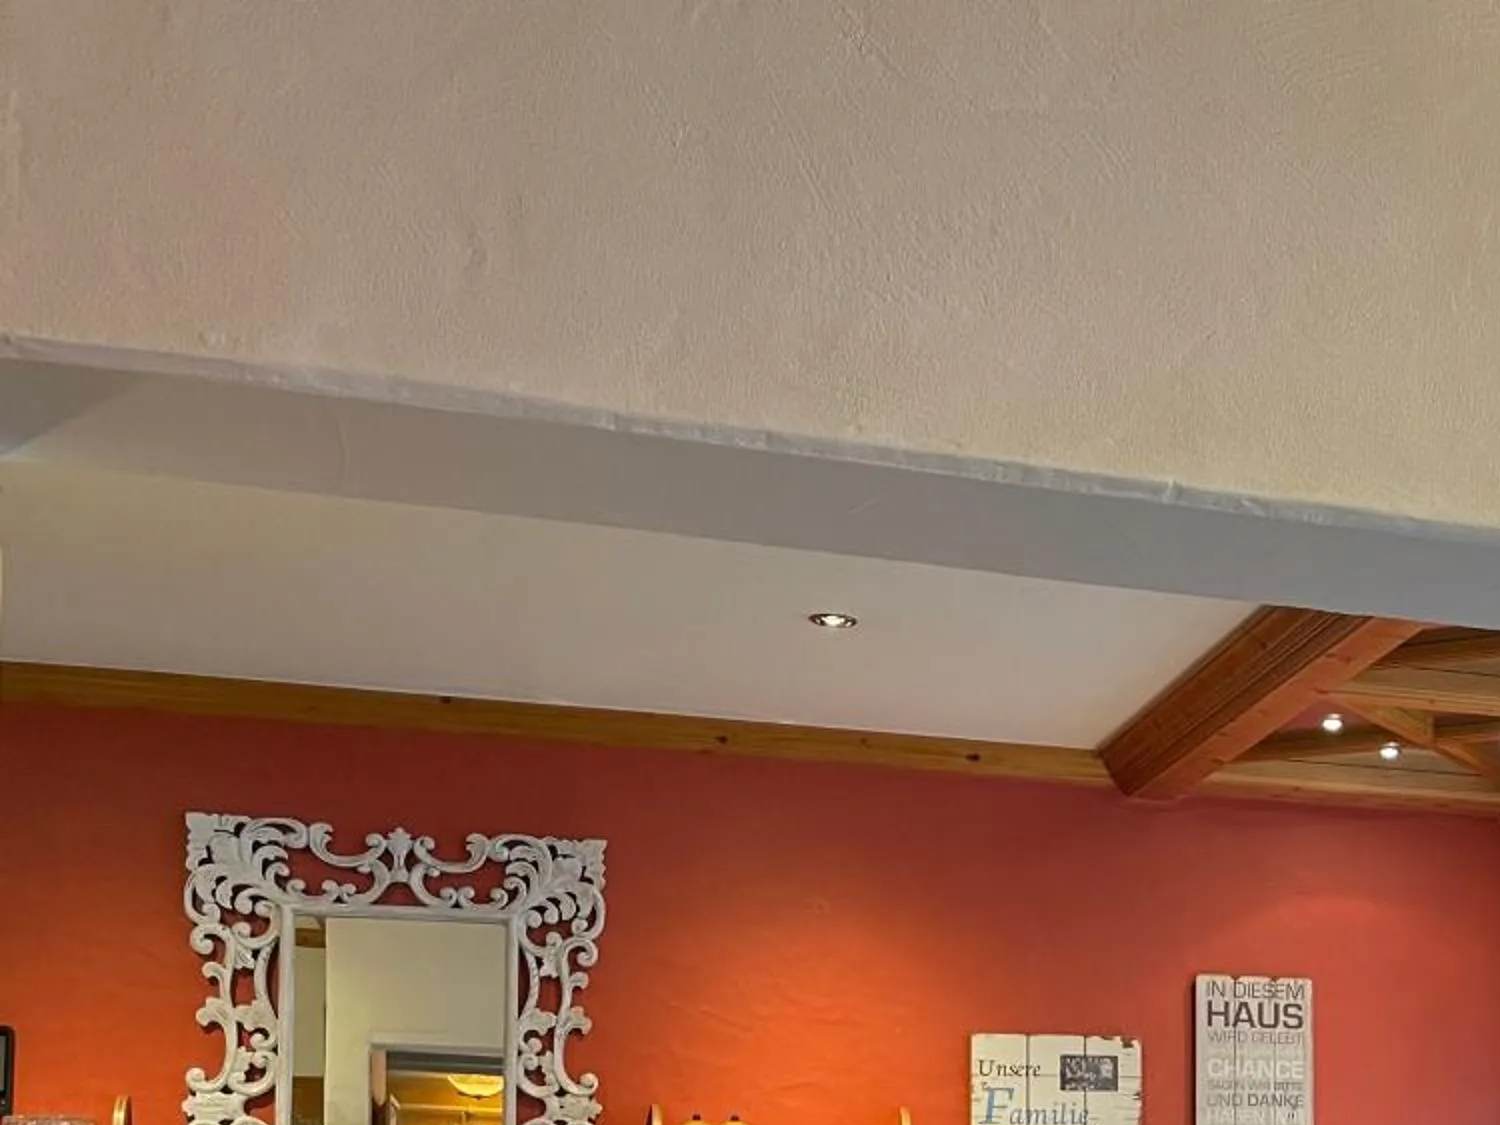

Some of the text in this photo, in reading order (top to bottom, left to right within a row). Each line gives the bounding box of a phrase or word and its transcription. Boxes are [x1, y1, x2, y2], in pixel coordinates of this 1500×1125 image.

[1207, 980, 1305, 1000] IN DIESEM
[1207, 1000, 1304, 1029] HAUS
[979, 1060, 1041, 1077] Unsere
[1208, 1059, 1304, 1079] CHANCE
[978, 1086, 1089, 1125] Familie
[1207, 1093, 1304, 1109] UND DANKE
